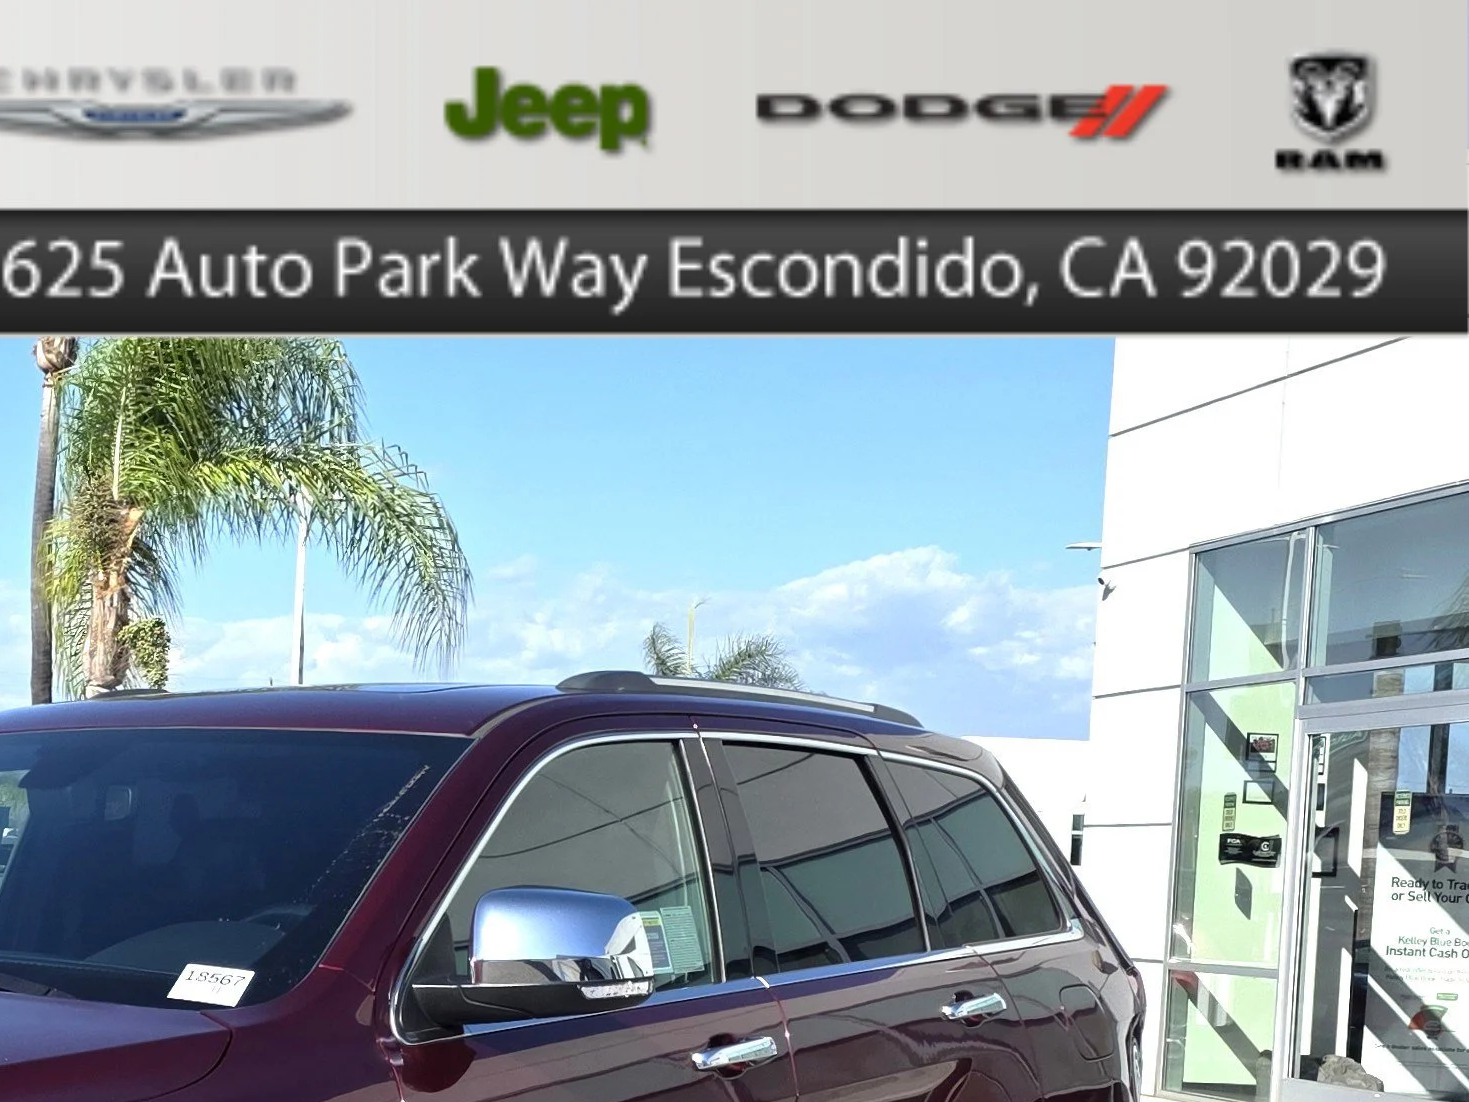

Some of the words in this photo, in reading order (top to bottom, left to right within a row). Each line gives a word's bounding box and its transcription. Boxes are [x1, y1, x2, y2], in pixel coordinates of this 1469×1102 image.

[1391, 876, 1430, 891] Ready
[1432, 879, 1443, 889] to
[1447, 878, 1469, 890] Tra
[1391, 892, 1405, 901] or
[1408, 890, 1431, 902] Sell
[1434, 891, 1462, 903] Your
[1429, 926, 1443, 935] Get
[1398, 936, 1427, 947] Kelley
[1430, 937, 1452, 946] Blue
[1385, 945, 1426, 957] Instant
[1429, 947, 1458, 959] Cash
